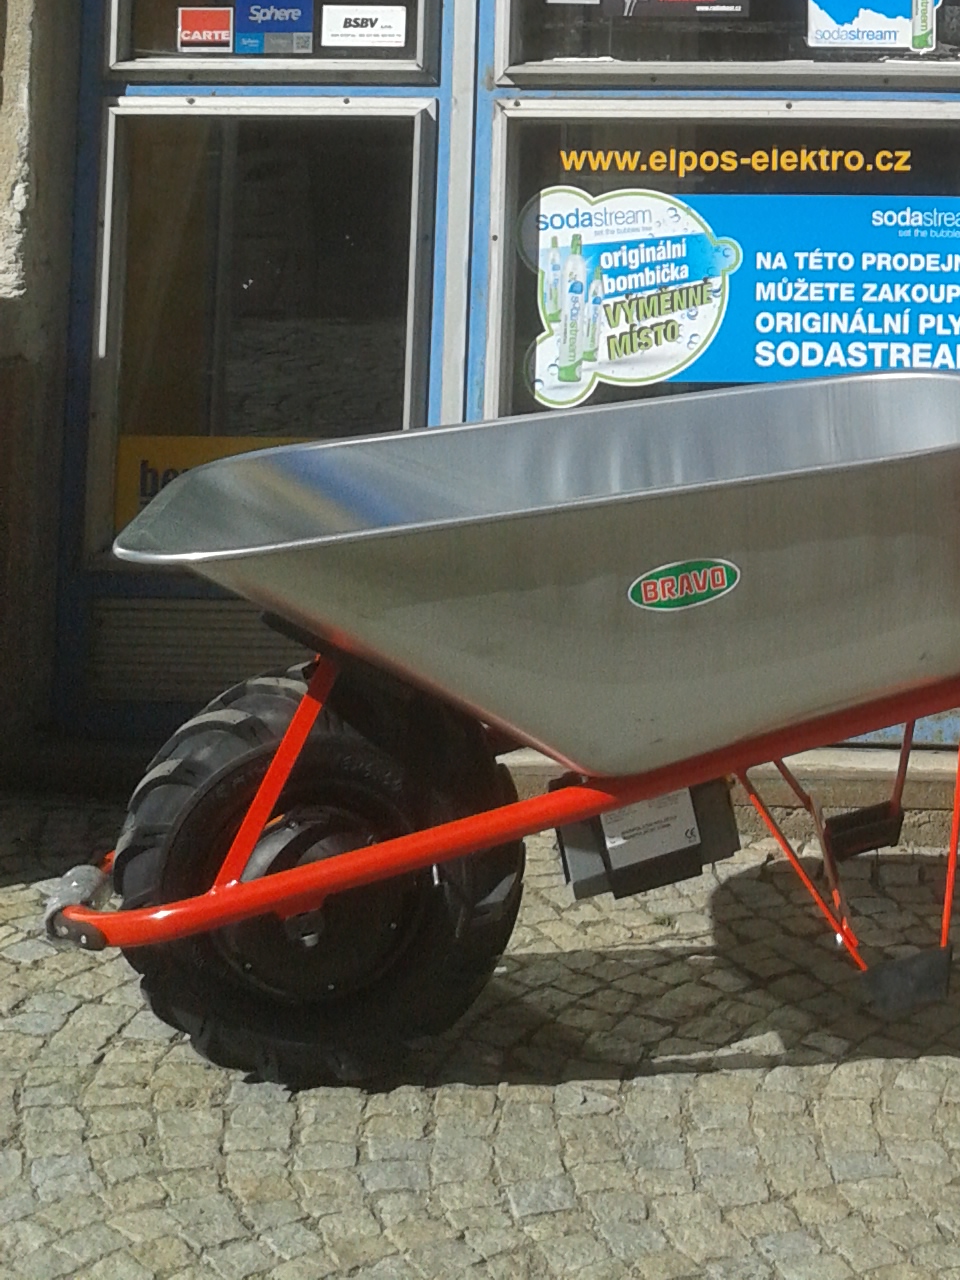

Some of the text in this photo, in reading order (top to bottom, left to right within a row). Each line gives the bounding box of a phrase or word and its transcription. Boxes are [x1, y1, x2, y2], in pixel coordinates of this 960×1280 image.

[248, 4, 302, 23] Sphere
[342, 17, 379, 29] BSBV
[181, 29, 230, 40] CARTE
[814, 27, 898, 41] sodastream
[559, 146, 912, 178] www.elpos-elektro.cz
[535, 206, 652, 232] sodastream
[600, 238, 688, 271] originální
[755, 251, 788, 271] NA
[794, 247, 855, 271] TÉTO
[601, 263, 690, 295] bombička
[755, 277, 855, 302] MŮŽETE
[603, 277, 714, 329] VÝMĚNNÉ
[755, 307, 911, 335] ORIGINÁLNÍ
[606, 319, 681, 361] MÍSTO
[640, 563, 728, 605] BRAVO
